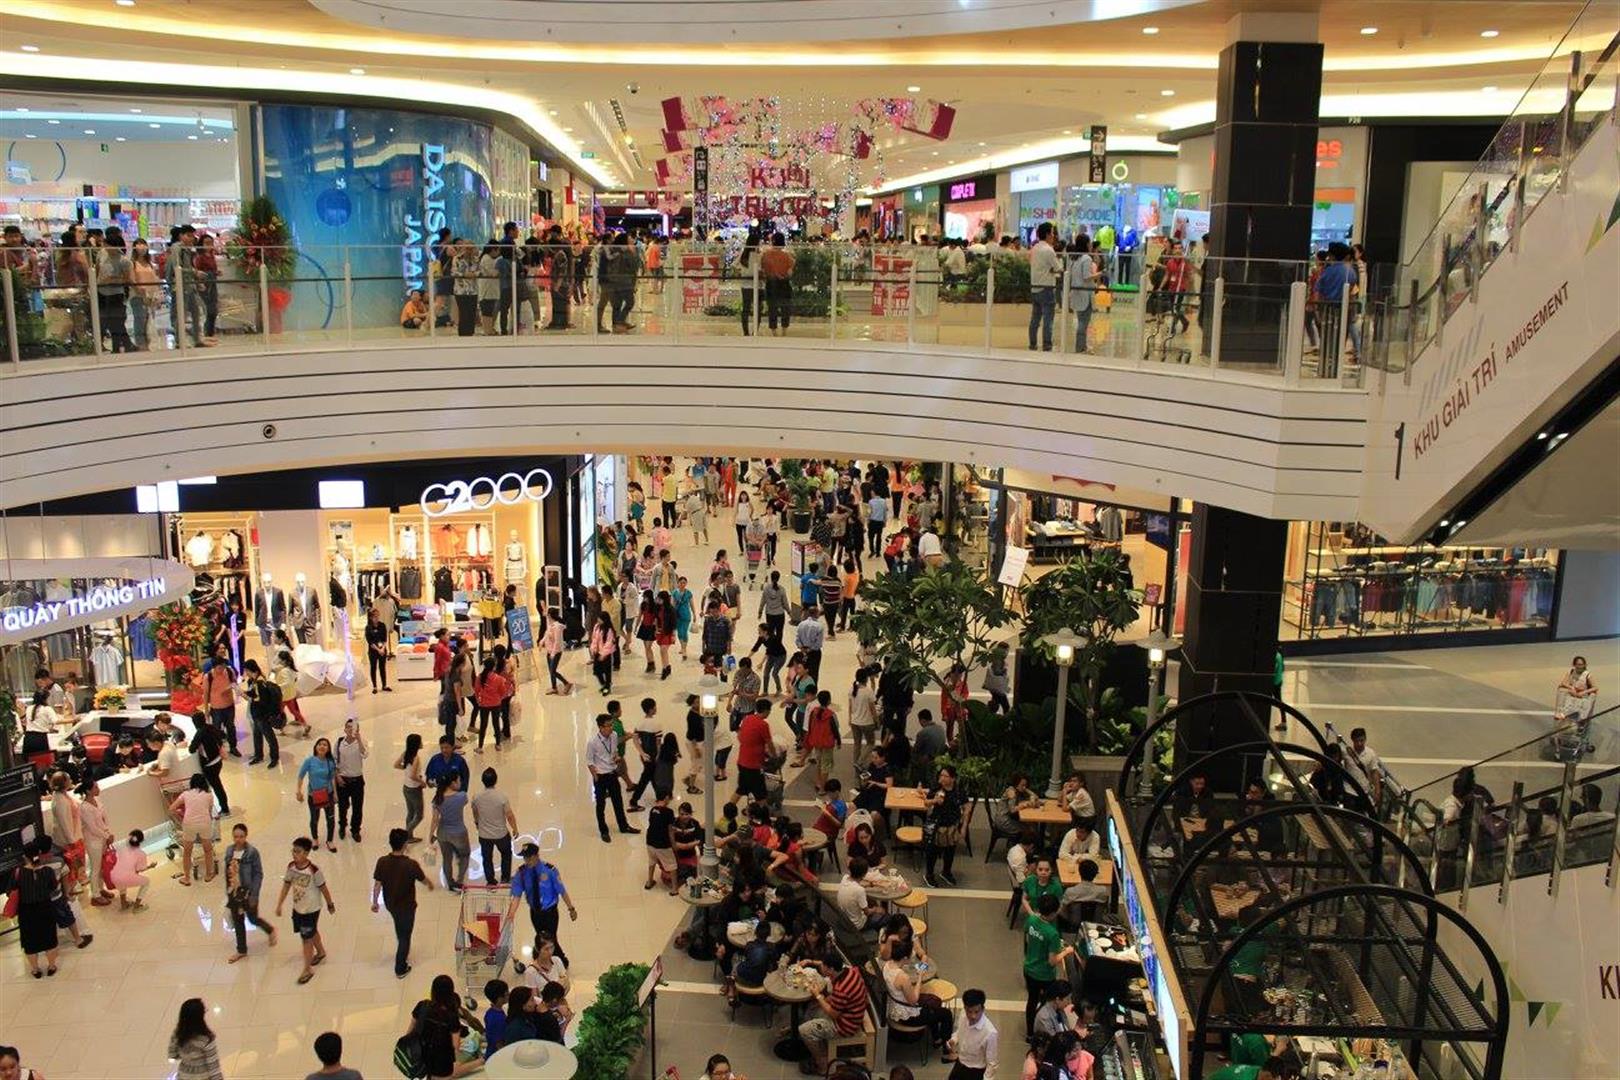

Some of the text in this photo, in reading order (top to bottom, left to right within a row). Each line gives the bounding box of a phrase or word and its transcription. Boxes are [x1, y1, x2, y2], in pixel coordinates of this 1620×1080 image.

[1413, 415, 1440, 460] KHU
[1472, 342, 1498, 396] TRÍ
[1504, 281, 1569, 363] AMUSEMENT
[420, 468, 553, 518] G2000
[66, 584, 135, 618] THÔNG
[137, 577, 166, 600] TIN
